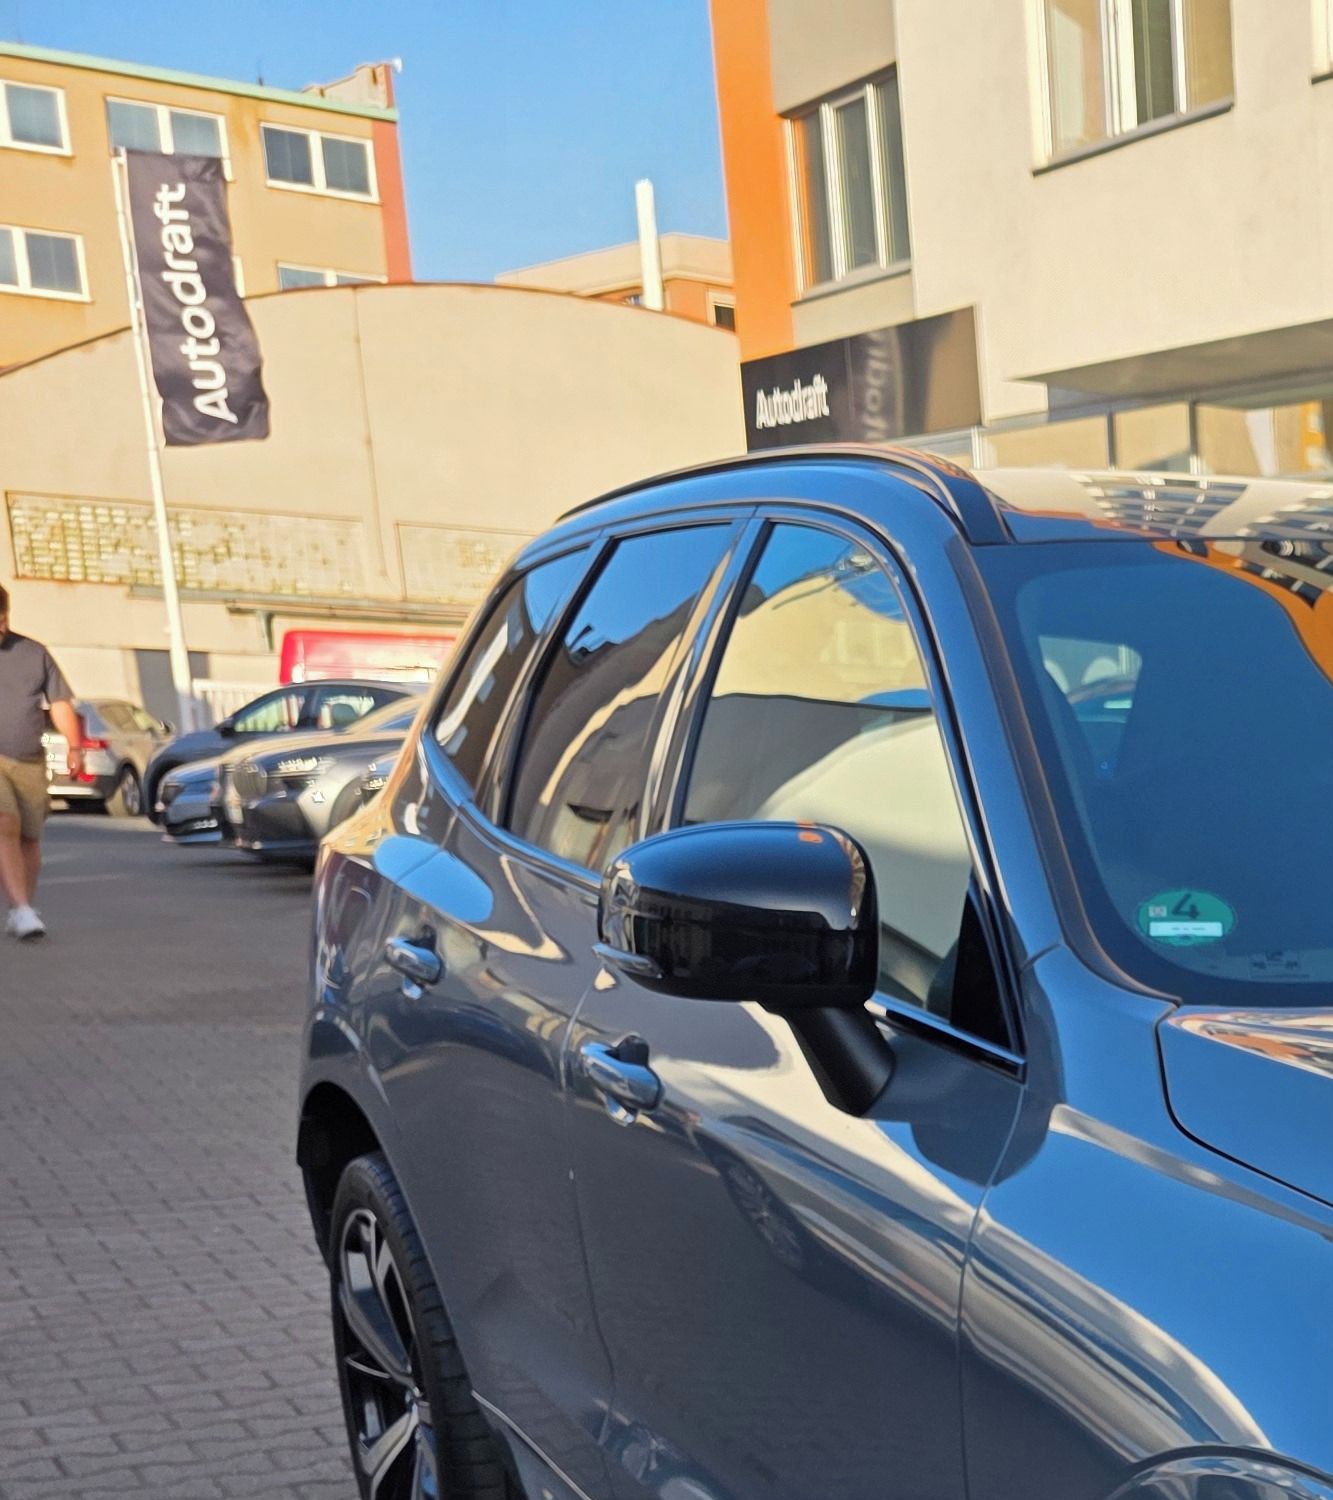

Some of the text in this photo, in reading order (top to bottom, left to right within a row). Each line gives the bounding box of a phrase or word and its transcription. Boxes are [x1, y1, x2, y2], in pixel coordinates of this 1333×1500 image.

[154, 183, 238, 424] Autodraft
[756, 374, 830, 429] Autodraft
[1171, 893, 1200, 919] 4
